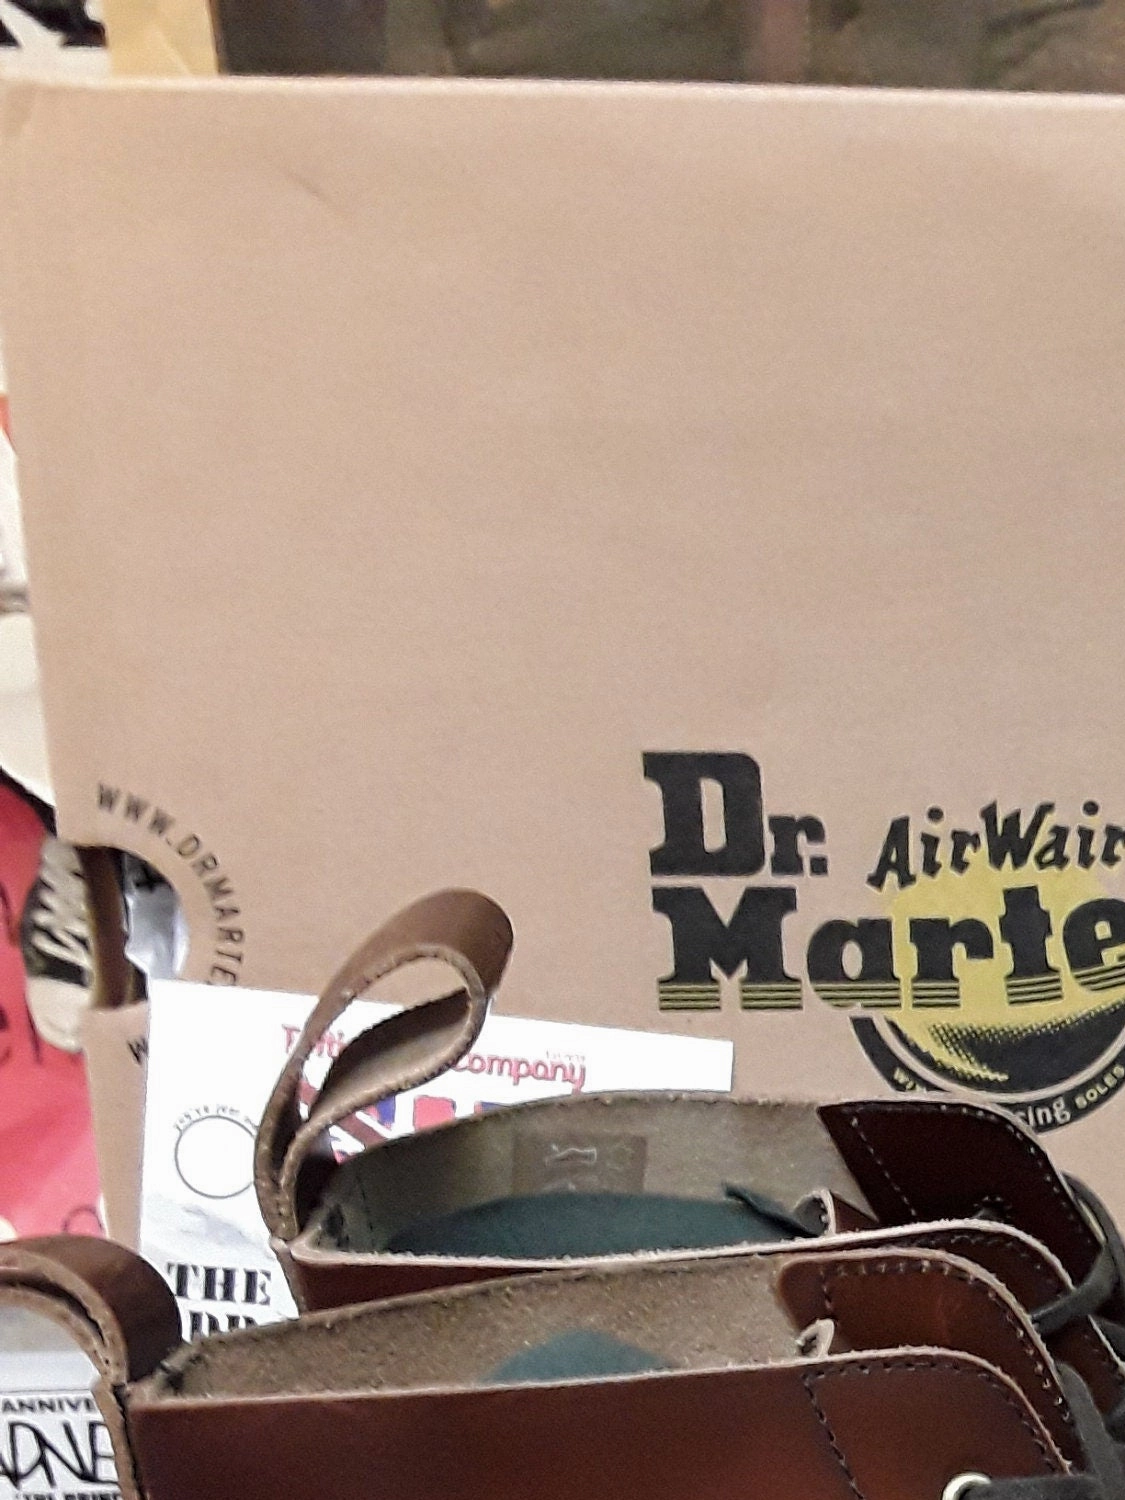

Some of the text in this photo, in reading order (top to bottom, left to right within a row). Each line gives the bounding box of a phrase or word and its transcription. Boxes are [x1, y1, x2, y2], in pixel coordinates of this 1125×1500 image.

[643, 752, 828, 876] Dr.
[1074, 1063, 1125, 1110] SOLES
[166, 1261, 271, 1305] THE
